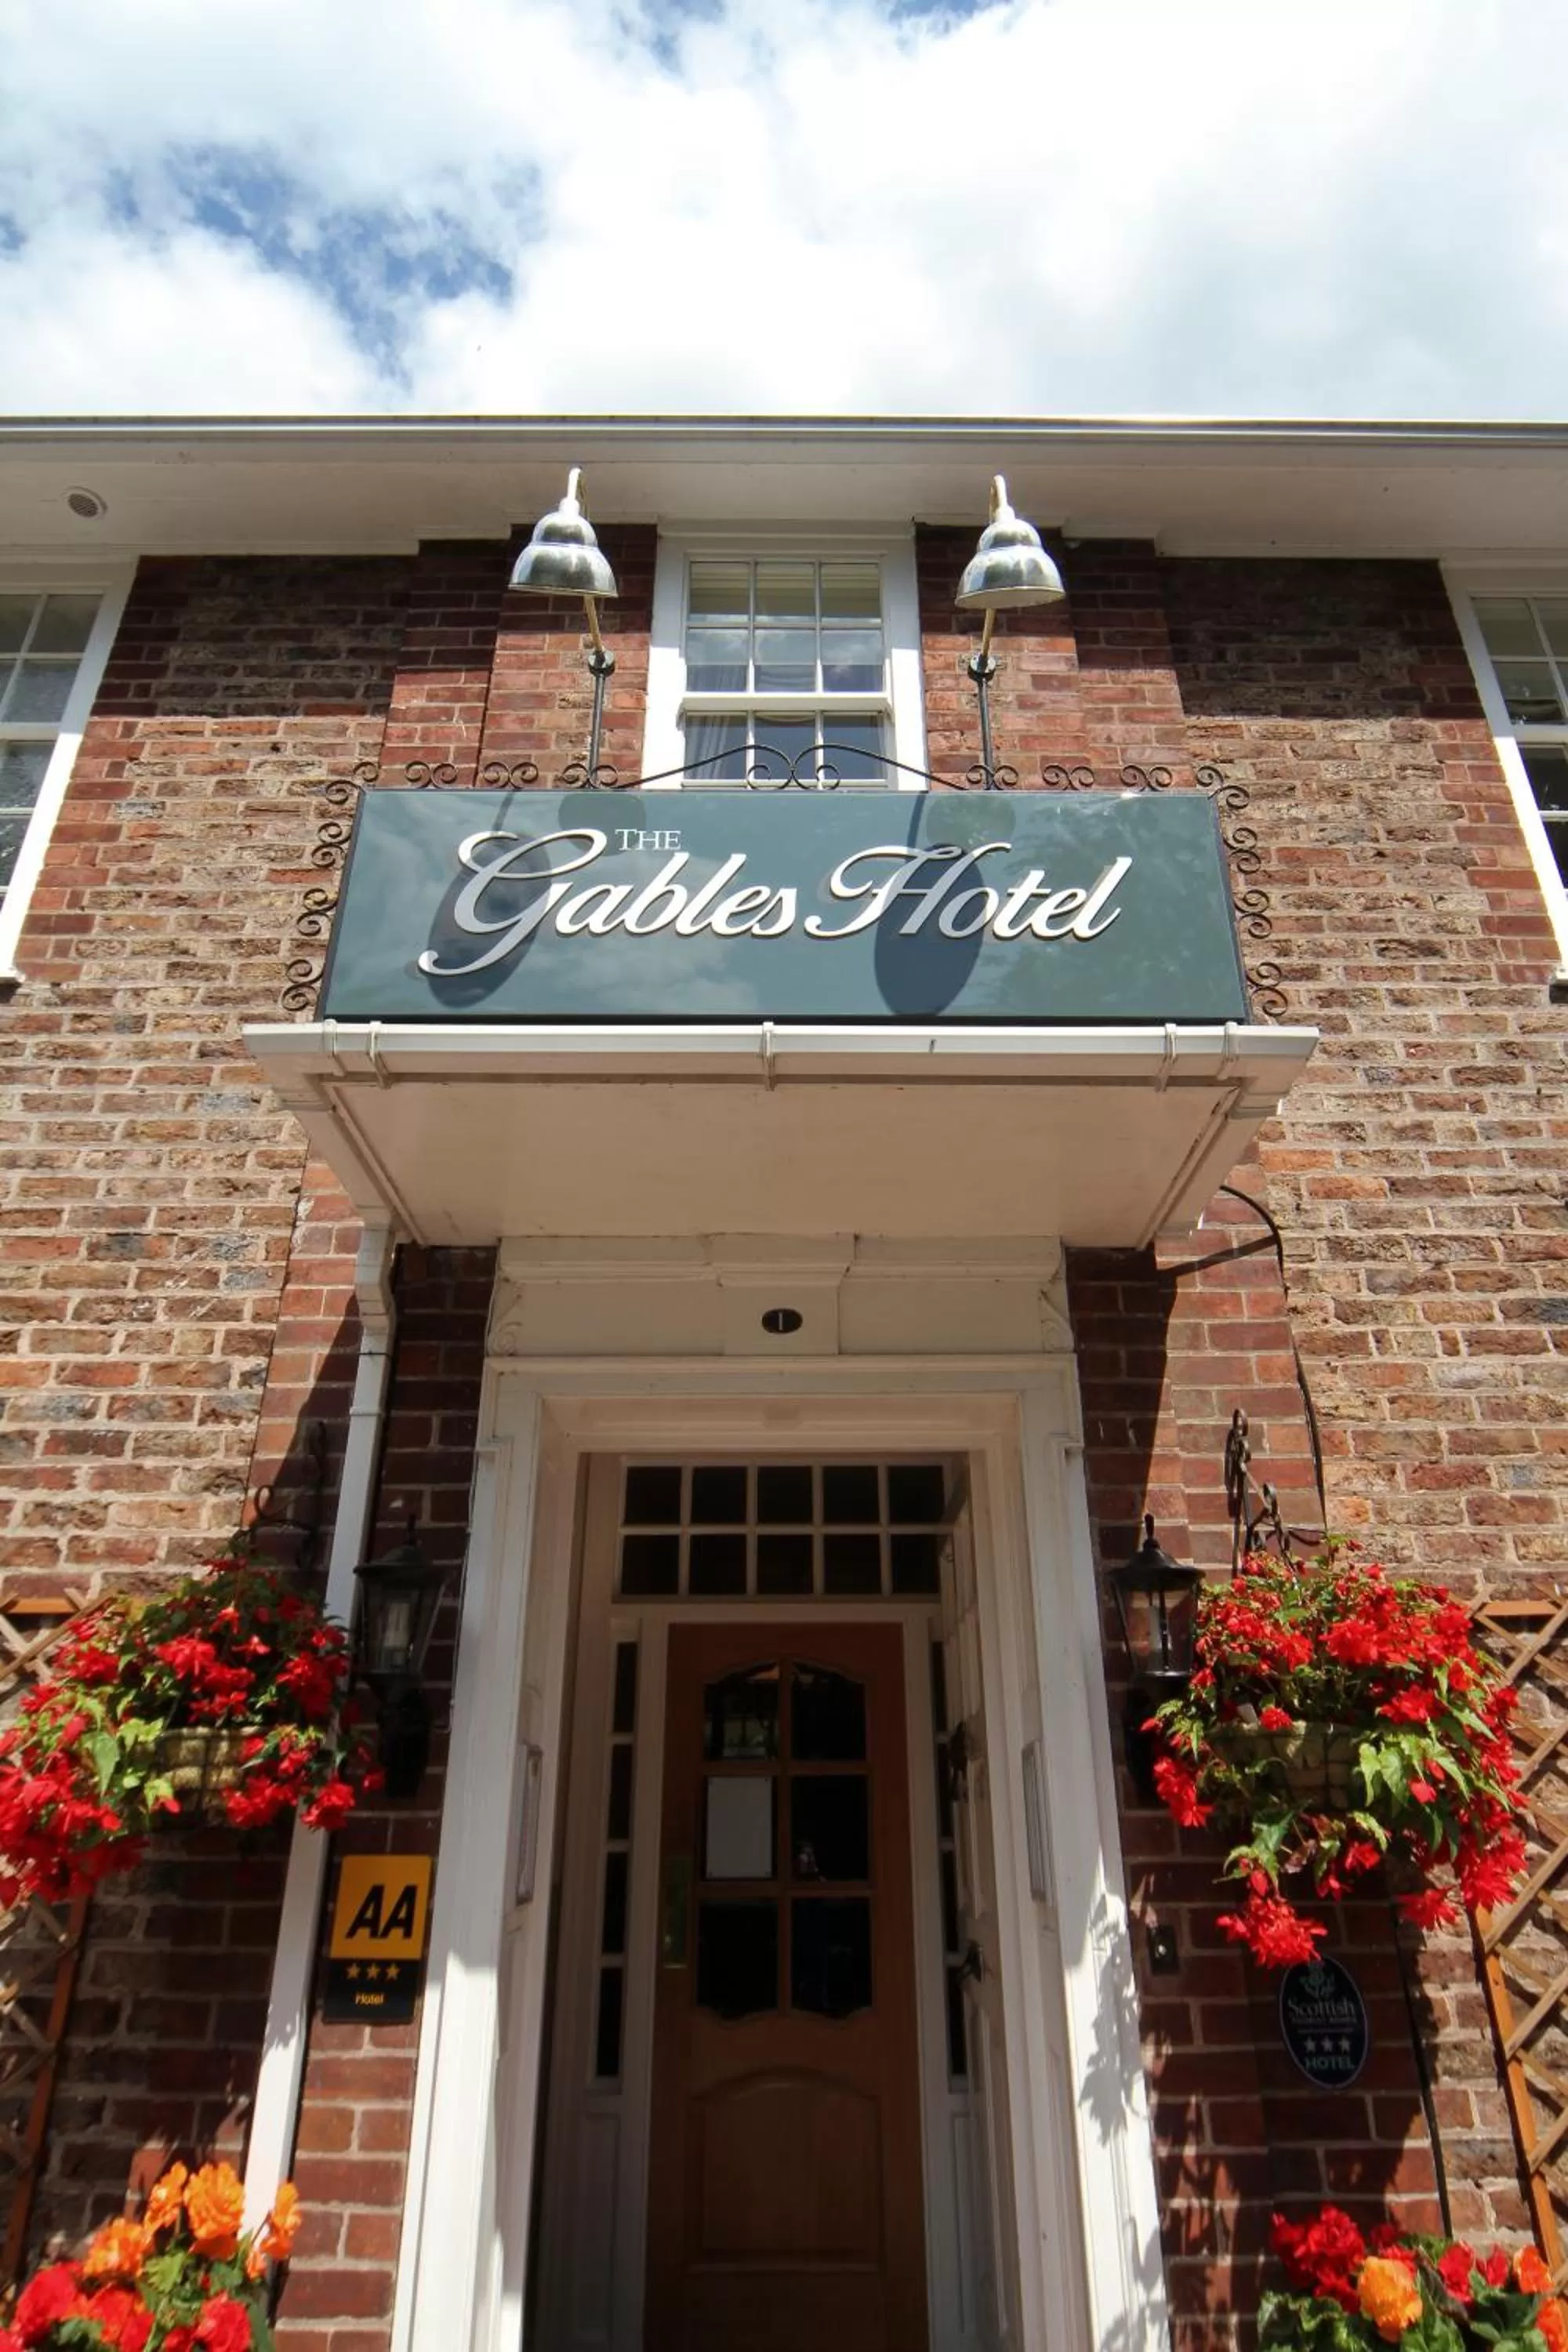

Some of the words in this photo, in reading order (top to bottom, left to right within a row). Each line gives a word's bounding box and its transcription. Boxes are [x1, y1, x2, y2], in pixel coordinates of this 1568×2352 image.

[615, 829, 681, 851] THE
[417, 828, 797, 977] Gables
[804, 842, 1133, 942] Hotel
[345, 1884, 419, 1939] AA
[355, 1991, 385, 2005] Hotel
[1287, 1996, 1356, 2018] Scottish
[1305, 2056, 1355, 2071] HOTEL
